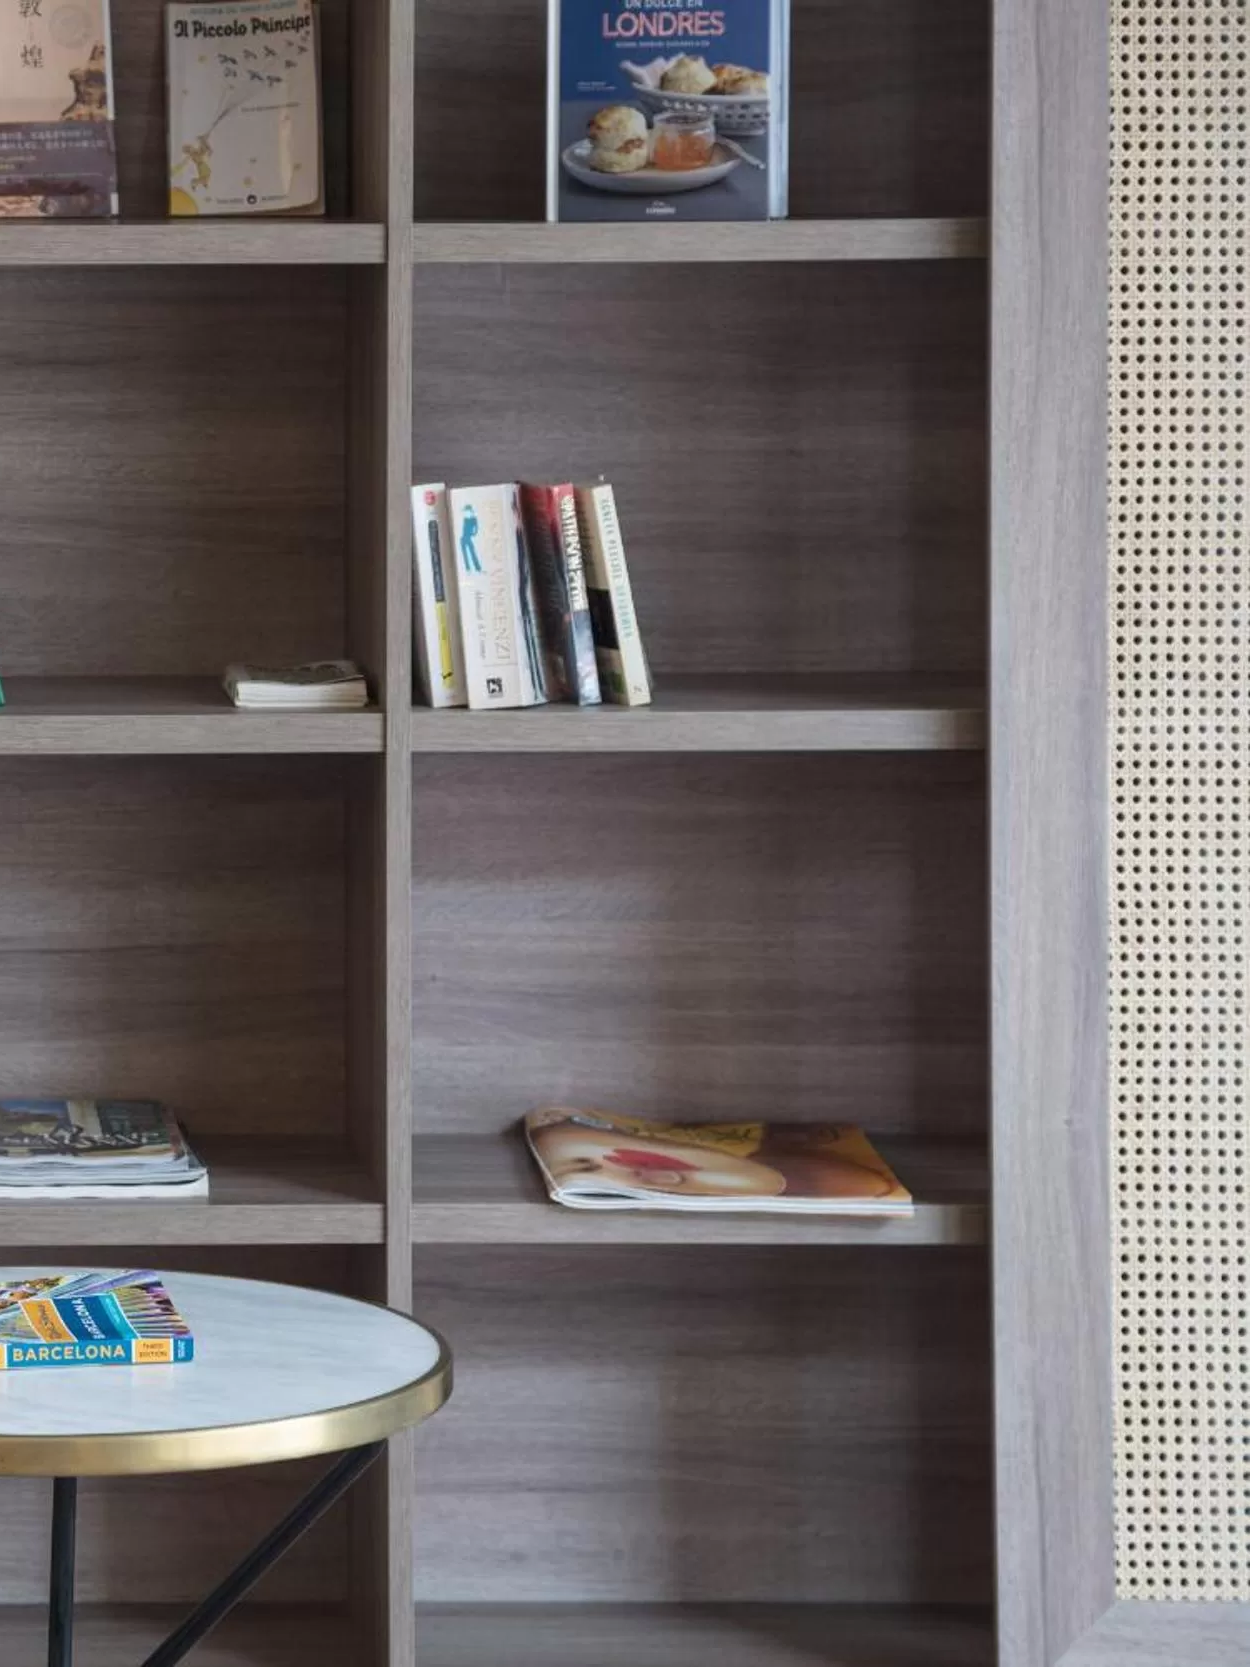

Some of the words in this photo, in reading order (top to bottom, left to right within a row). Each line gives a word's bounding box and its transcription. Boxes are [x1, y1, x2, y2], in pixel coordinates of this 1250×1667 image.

[174, 19, 188, 37] Il
[191, 19, 247, 38] Piccolo
[602, 11, 725, 36] LONDRES
[12, 1344, 126, 1361] BARCELONA
